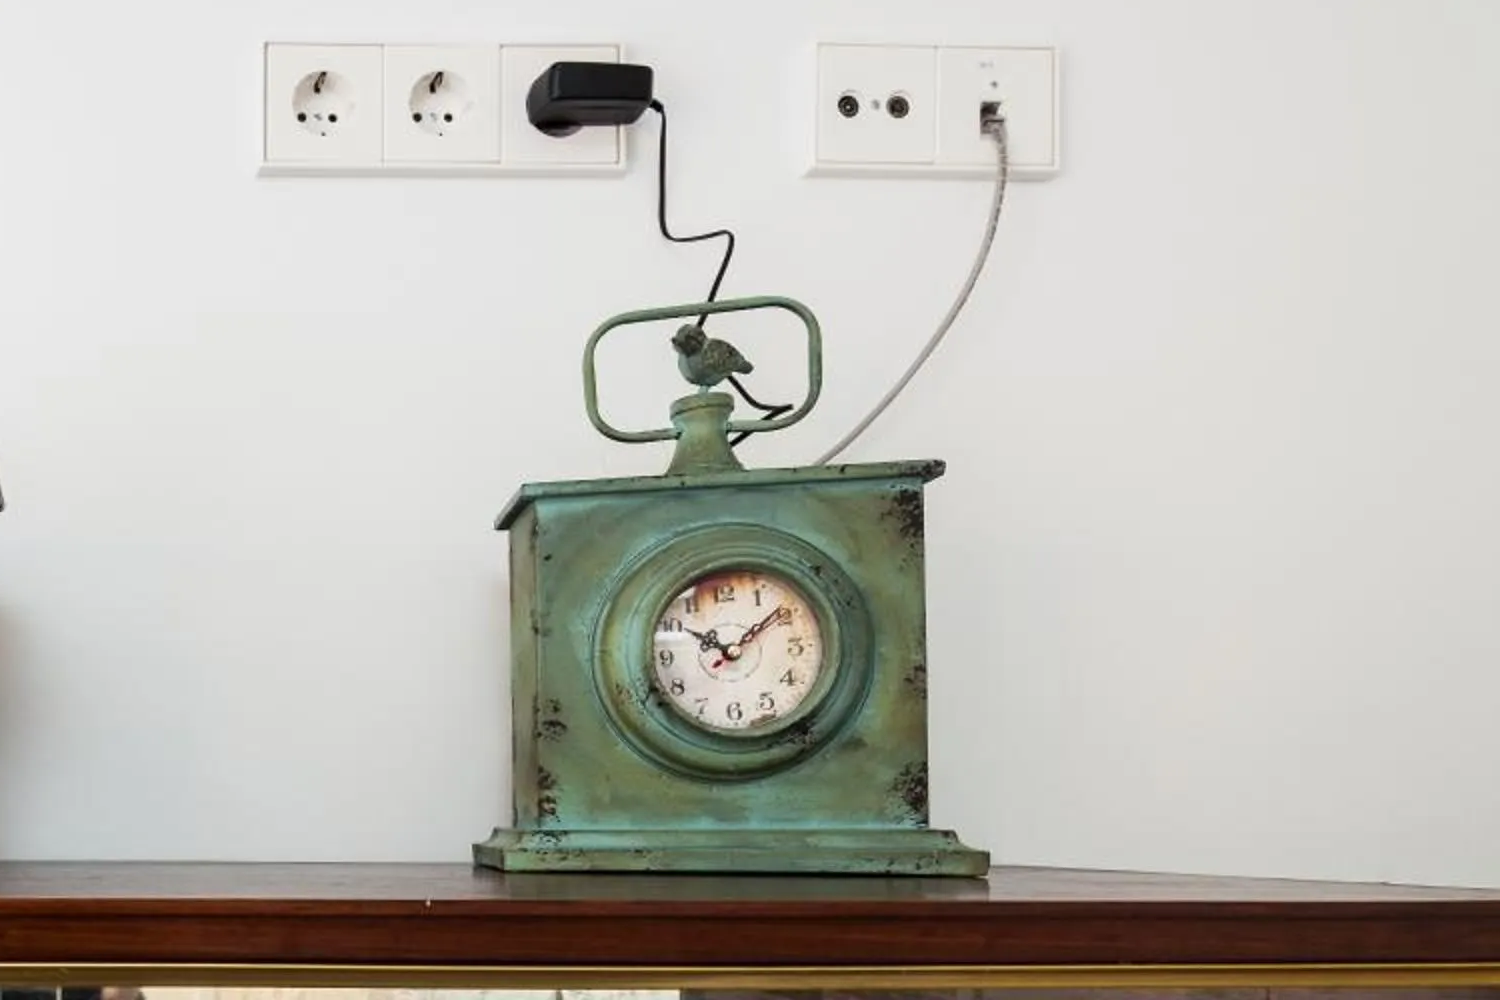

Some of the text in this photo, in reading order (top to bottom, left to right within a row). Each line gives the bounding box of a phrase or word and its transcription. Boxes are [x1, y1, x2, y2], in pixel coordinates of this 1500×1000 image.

[714, 584, 734, 603] 12
[663, 617, 682, 632] 10
[787, 637, 804, 656] 3
[660, 650, 674, 665] 9
[779, 669, 796, 686] 4
[670, 679, 685, 696] 8
[759, 692, 775, 710] 5
[727, 702, 743, 720] 6
